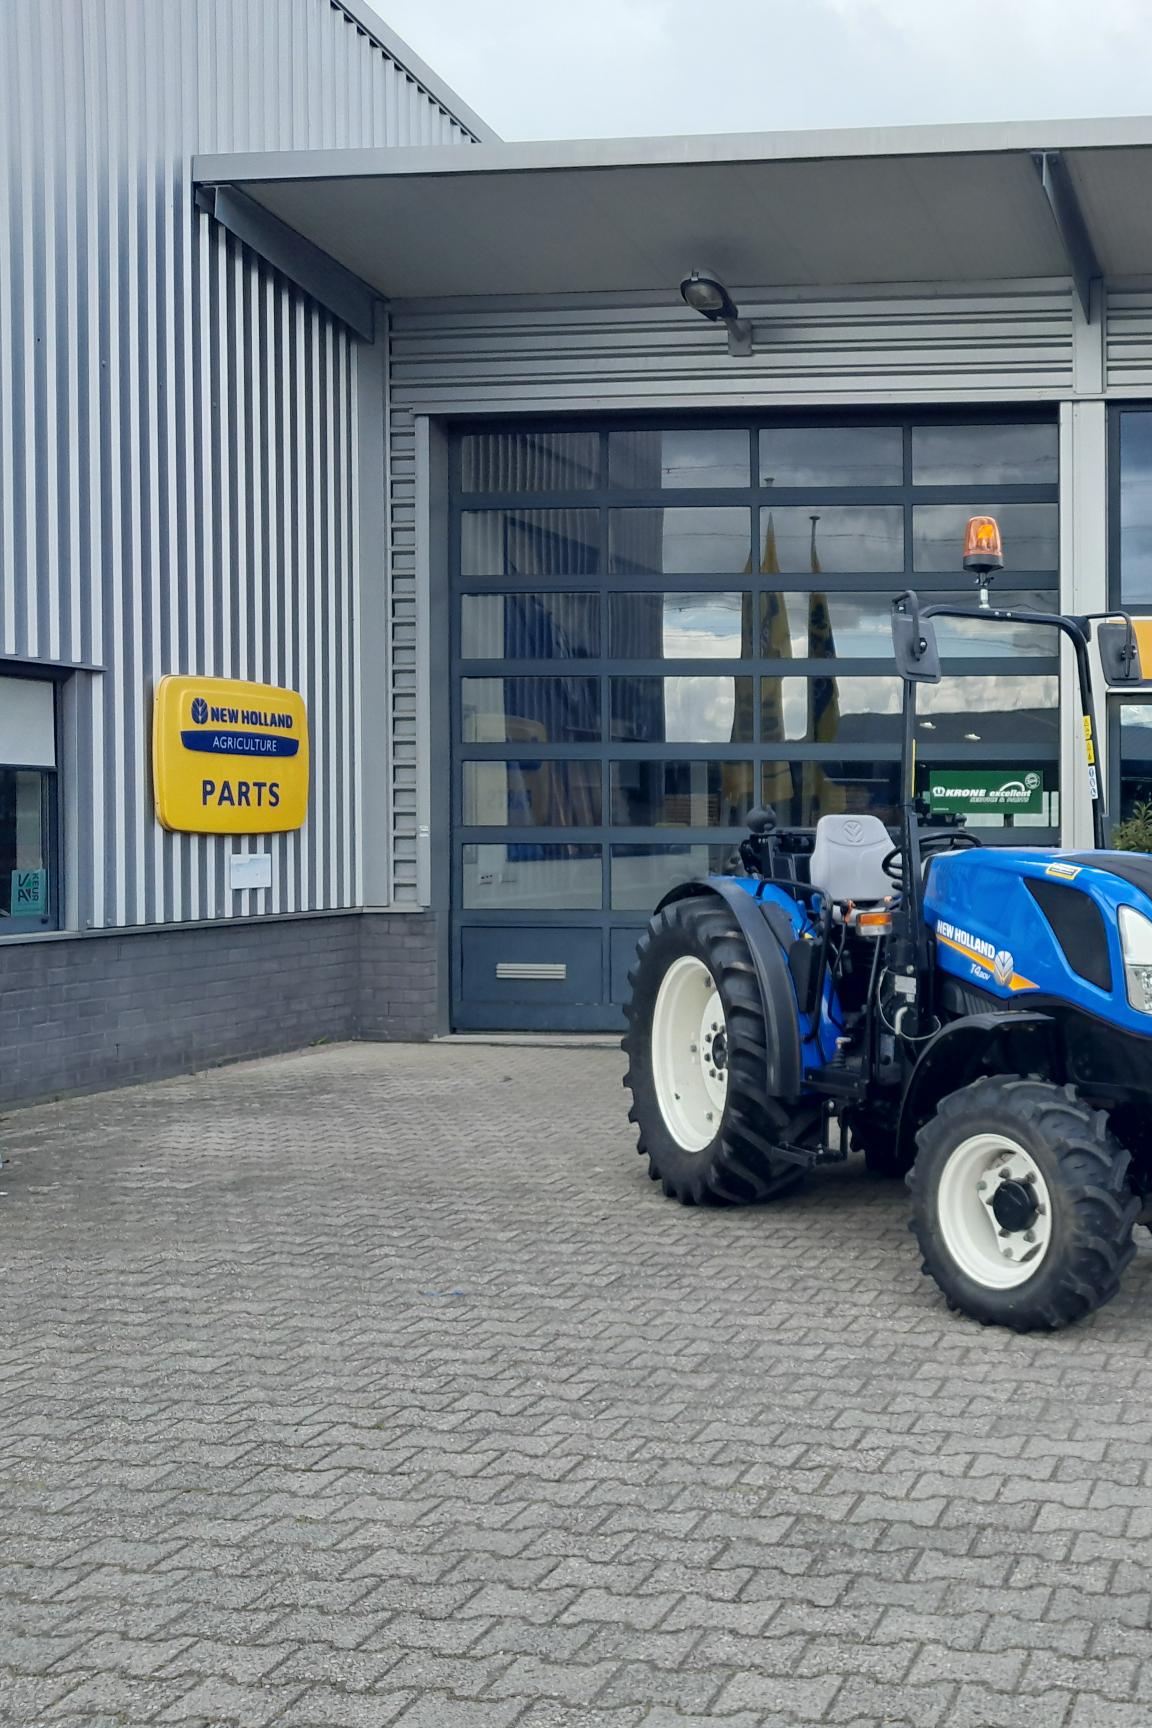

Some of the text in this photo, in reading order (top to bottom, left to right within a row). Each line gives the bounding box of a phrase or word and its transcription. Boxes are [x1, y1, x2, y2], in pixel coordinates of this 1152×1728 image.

[210, 706, 293, 729] NEW HOLLAND
[212, 736, 277, 752] AGRICULTURE
[202, 780, 280, 807] PARTS
[945, 789, 1032, 797] KRONE excellent
[936, 919, 996, 959] NEW HOLLAND
